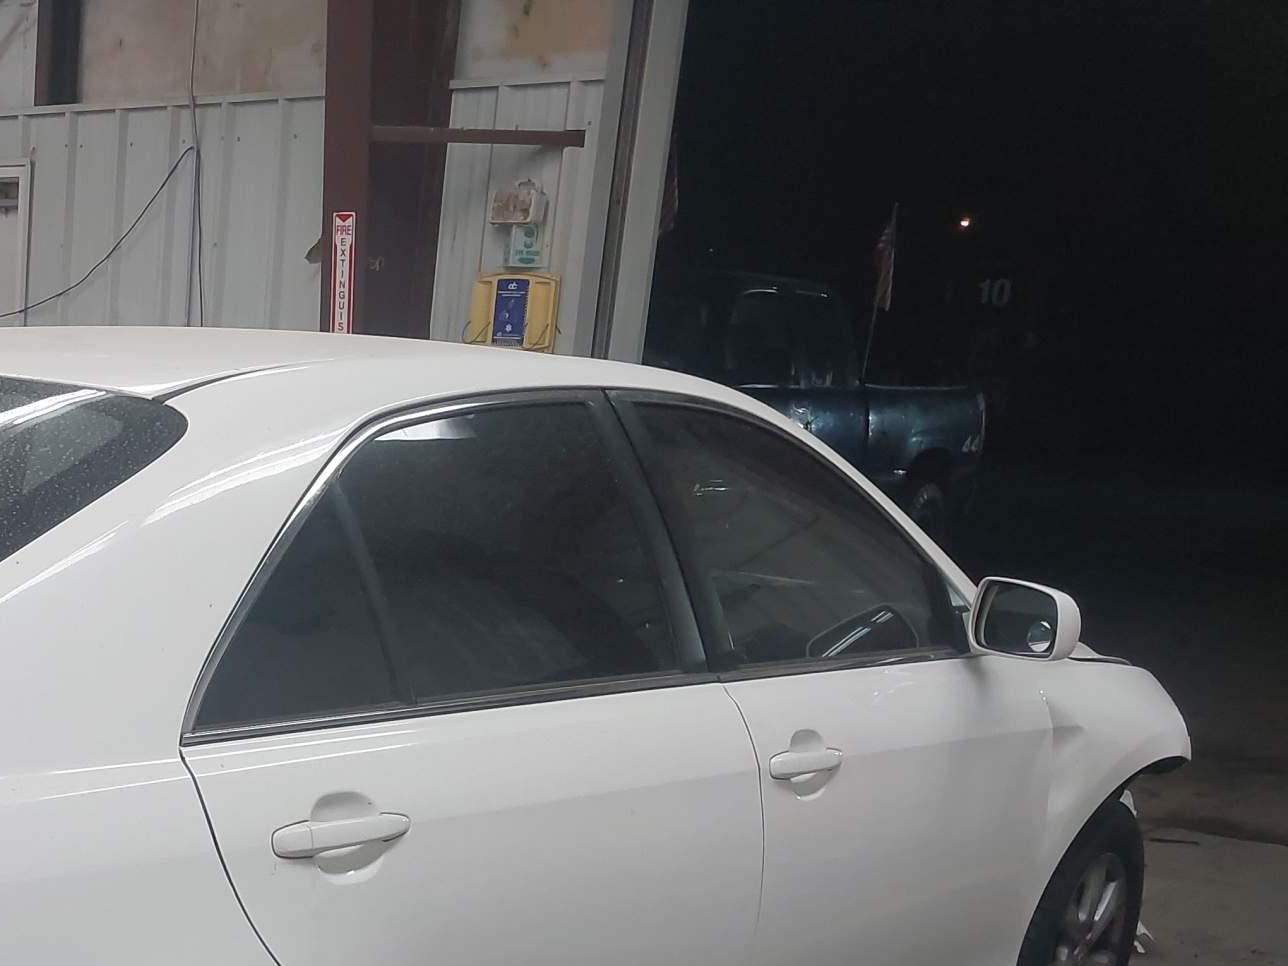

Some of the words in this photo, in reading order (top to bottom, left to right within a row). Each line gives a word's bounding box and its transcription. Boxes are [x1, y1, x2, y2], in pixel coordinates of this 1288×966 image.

[336, 224, 352, 236] FIRE
[338, 237, 347, 331] EXTINGUIS
[976, 278, 1012, 307] 10
